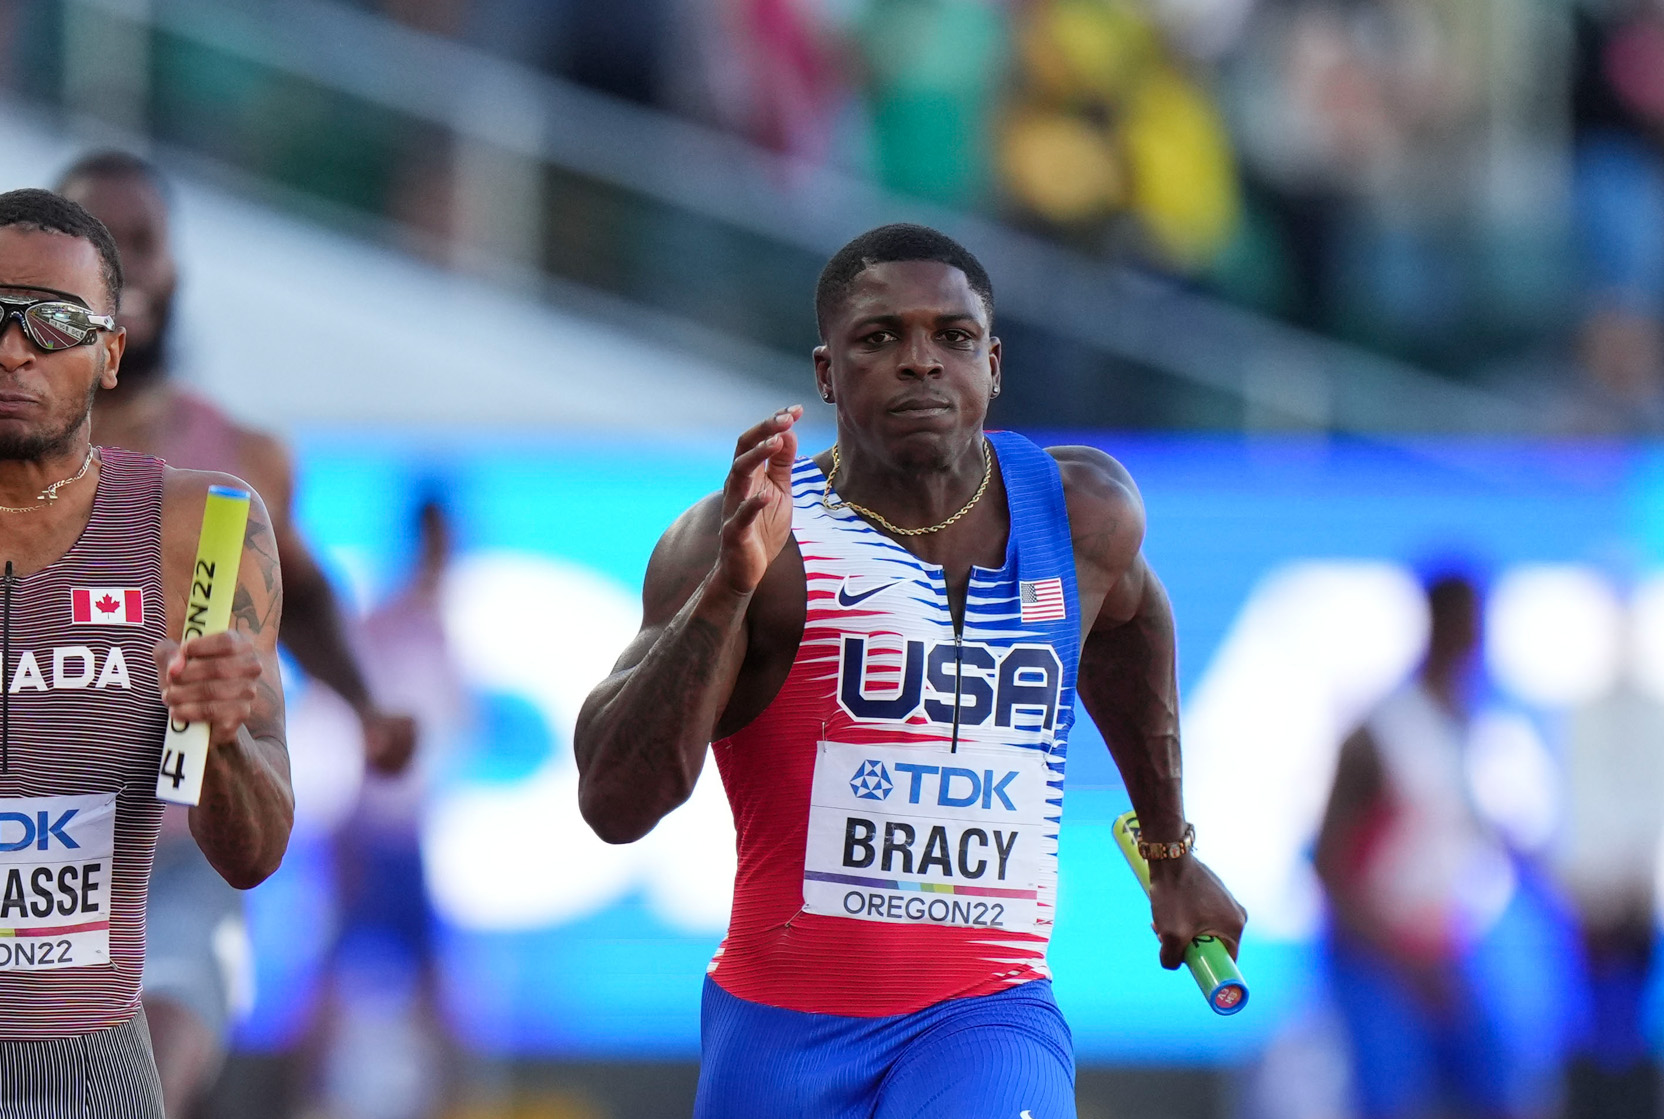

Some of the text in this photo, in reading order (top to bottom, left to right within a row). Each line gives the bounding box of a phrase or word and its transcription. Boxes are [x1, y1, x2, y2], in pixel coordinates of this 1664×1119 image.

[836, 633, 1064, 732] USA
[160, 749, 186, 789] 4
[894, 762, 1020, 812] TDK
[842, 816, 1019, 881] BRACY
[843, 890, 1005, 927] OREGON22
